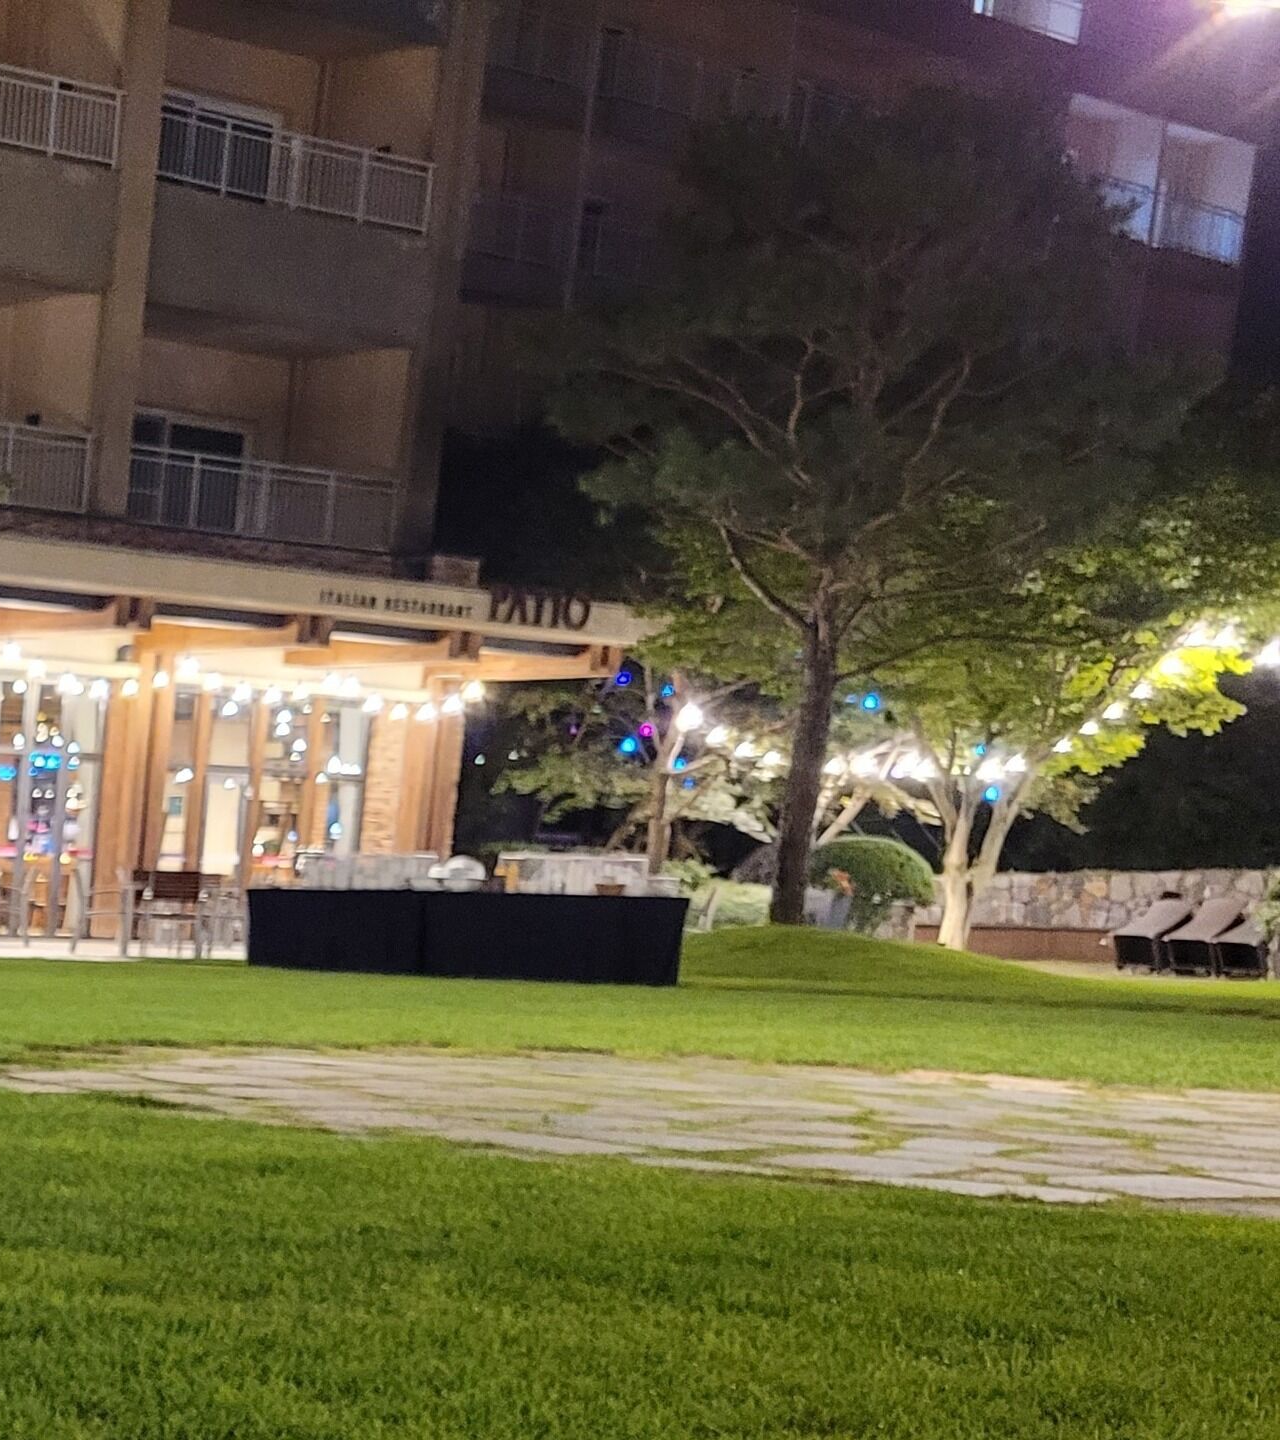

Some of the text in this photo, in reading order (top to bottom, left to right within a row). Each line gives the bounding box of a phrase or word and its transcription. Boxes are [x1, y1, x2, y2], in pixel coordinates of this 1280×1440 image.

[320, 588, 591, 631] ITALIAN RESTAURANT PATIO
